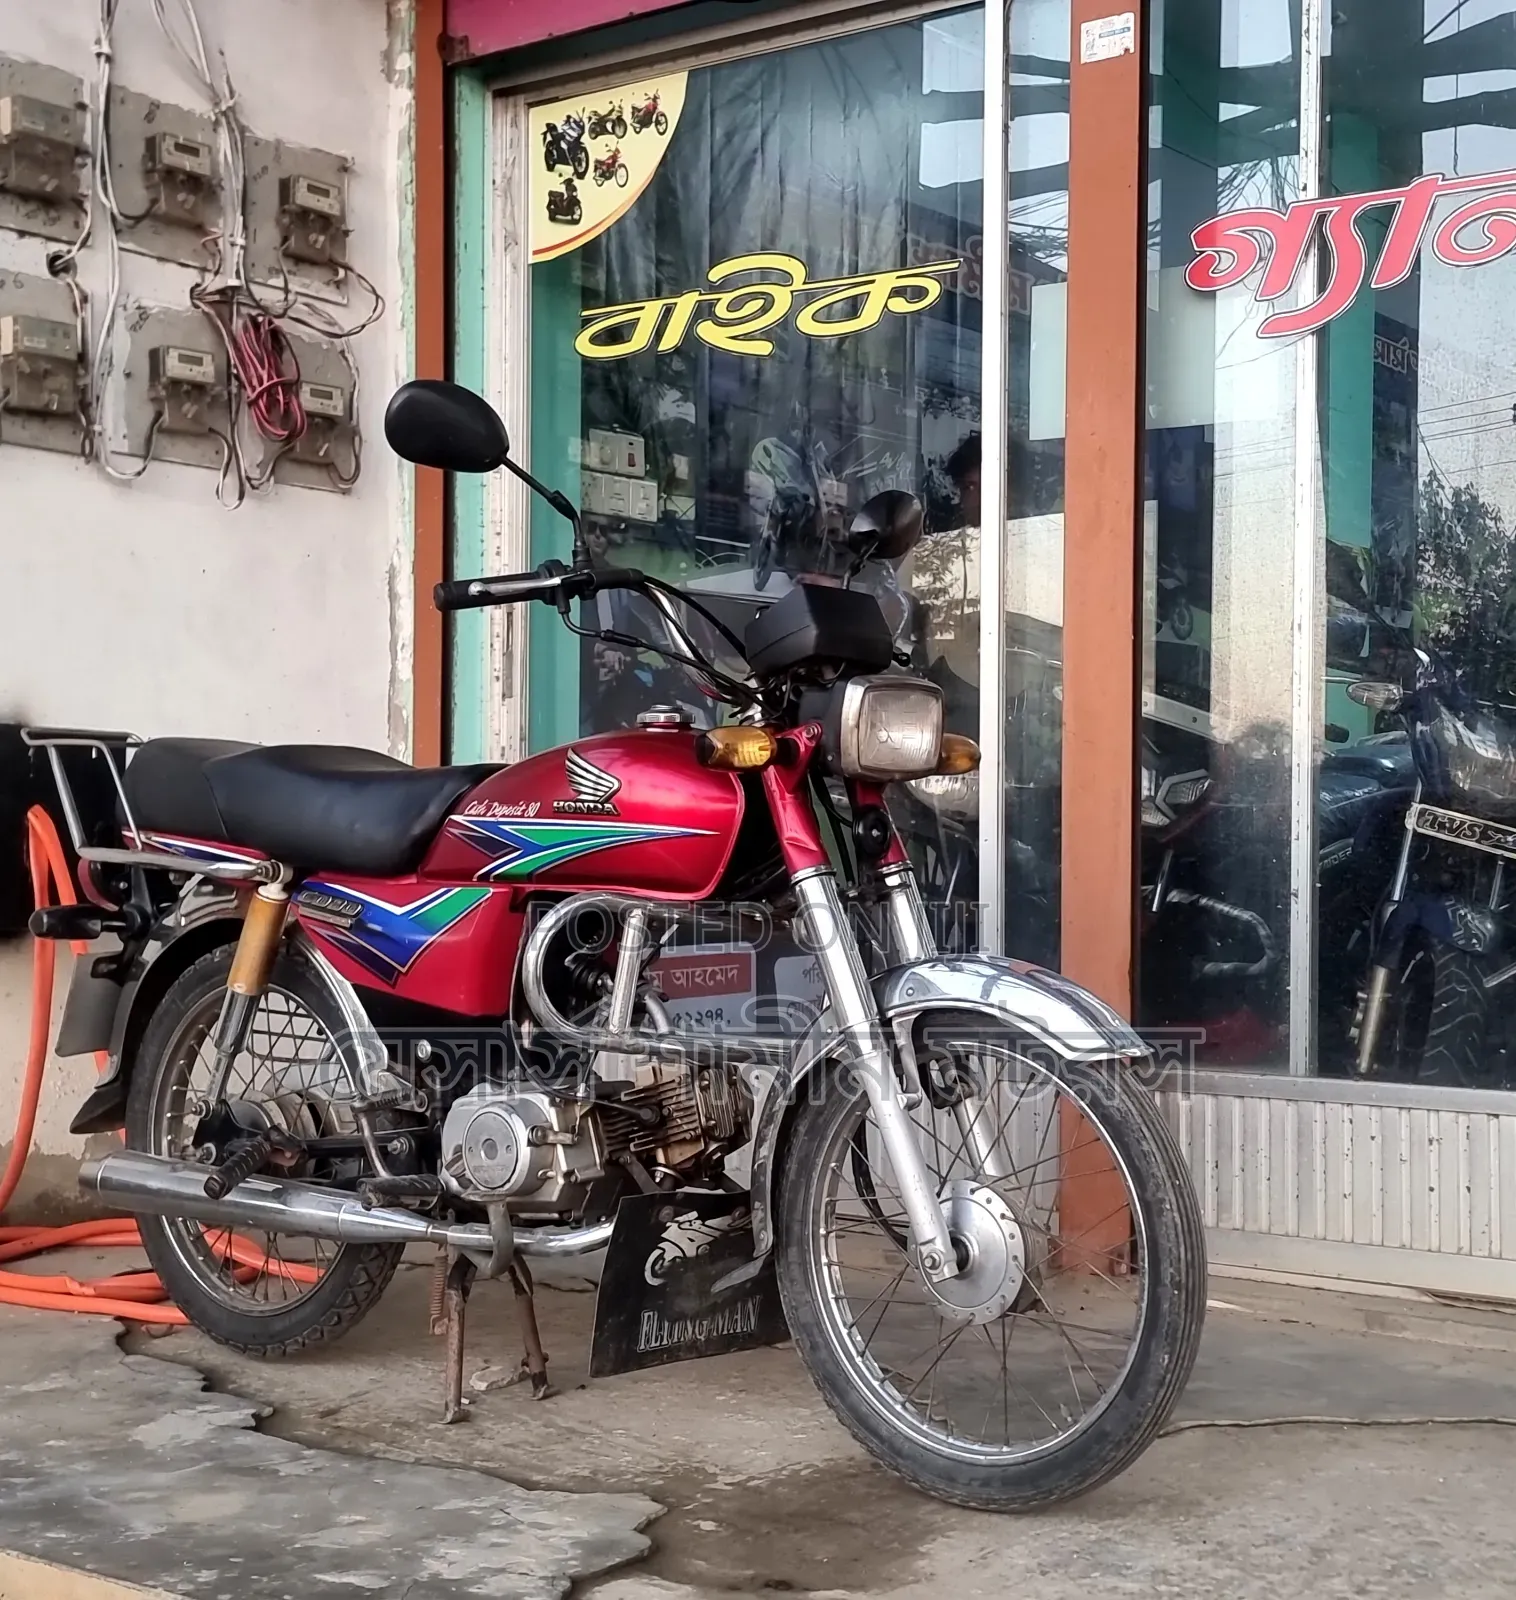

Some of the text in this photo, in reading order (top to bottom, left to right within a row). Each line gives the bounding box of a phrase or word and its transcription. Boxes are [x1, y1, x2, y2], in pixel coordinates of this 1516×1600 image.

[573, 250, 964, 359] বাইক
[487, 800, 526, 818] Deposit
[525, 801, 541, 817] 80
[553, 800, 619, 815] HONDA
[1424, 811, 1484, 841] TVS
[670, 963, 740, 989] আহমেদ
